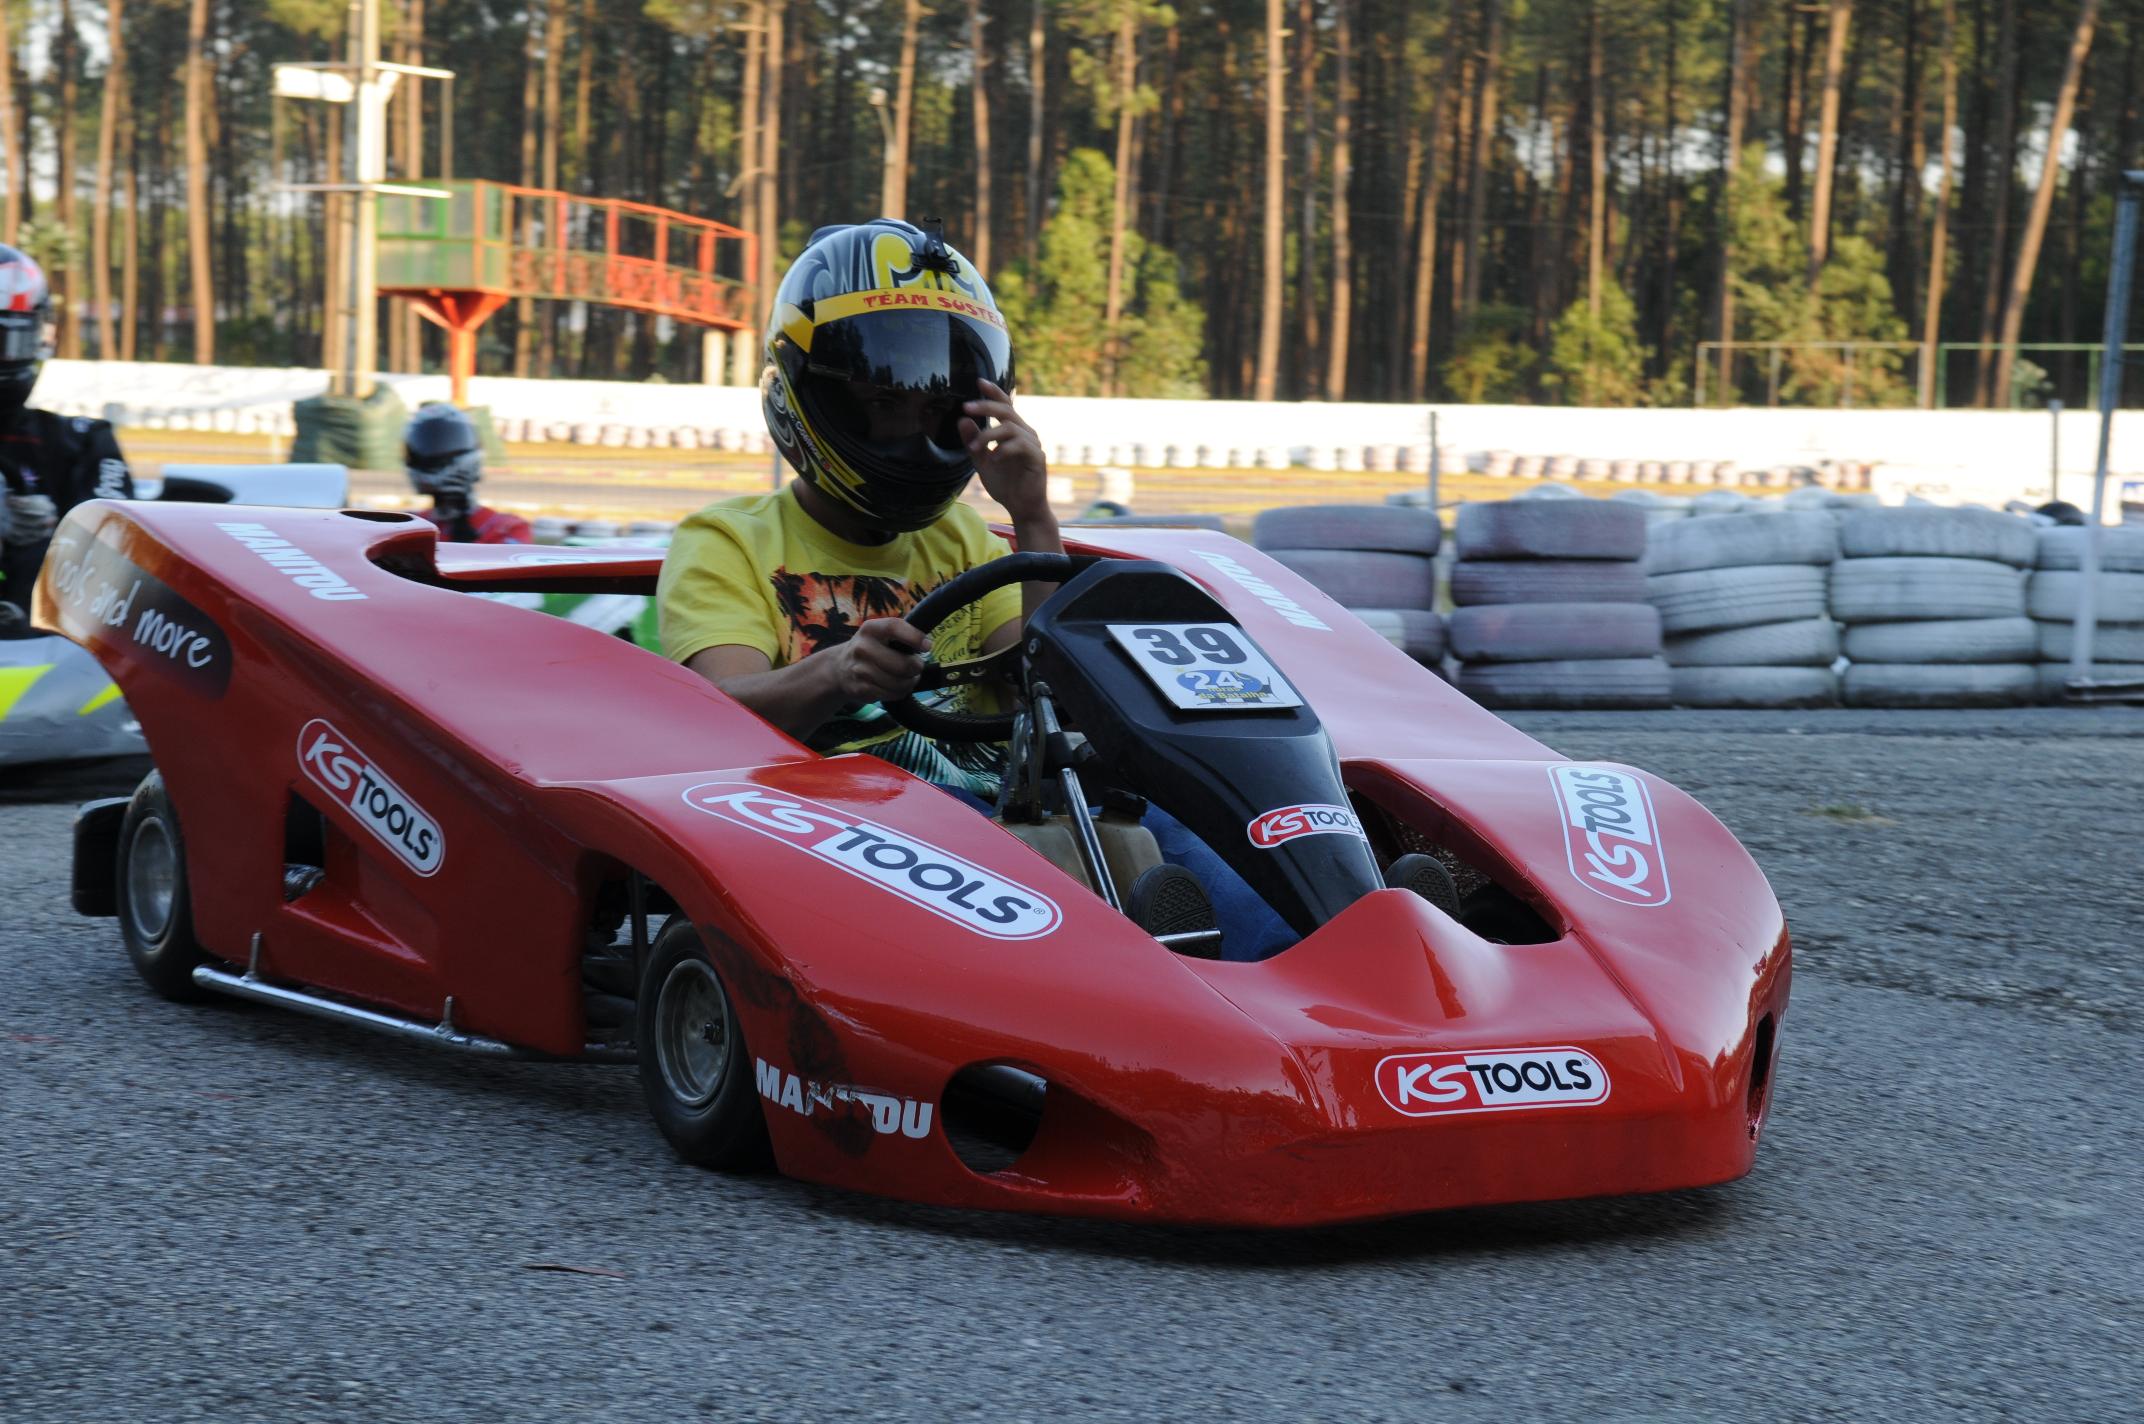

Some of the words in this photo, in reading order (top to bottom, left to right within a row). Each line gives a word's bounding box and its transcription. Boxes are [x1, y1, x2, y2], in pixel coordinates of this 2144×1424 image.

[864, 293, 929, 308] TEAM
[214, 522, 369, 600] MANITOU
[89, 580, 141, 627] and
[1133, 627, 1248, 666] 39
[1184, 671, 1244, 690] 24
[304, 732, 363, 791] KS
[359, 771, 434, 861] TOOLS
[1569, 771, 1636, 835] TOOLS
[1261, 811, 1304, 842] KS
[703, 791, 849, 834] KS
[836, 825, 1032, 924] TOOLS
[1584, 829, 1652, 897] KS
[756, 1057, 934, 1139] MANOU
[1397, 1063, 1470, 1105] KS
[1465, 1059, 1593, 1095] TOOLS
